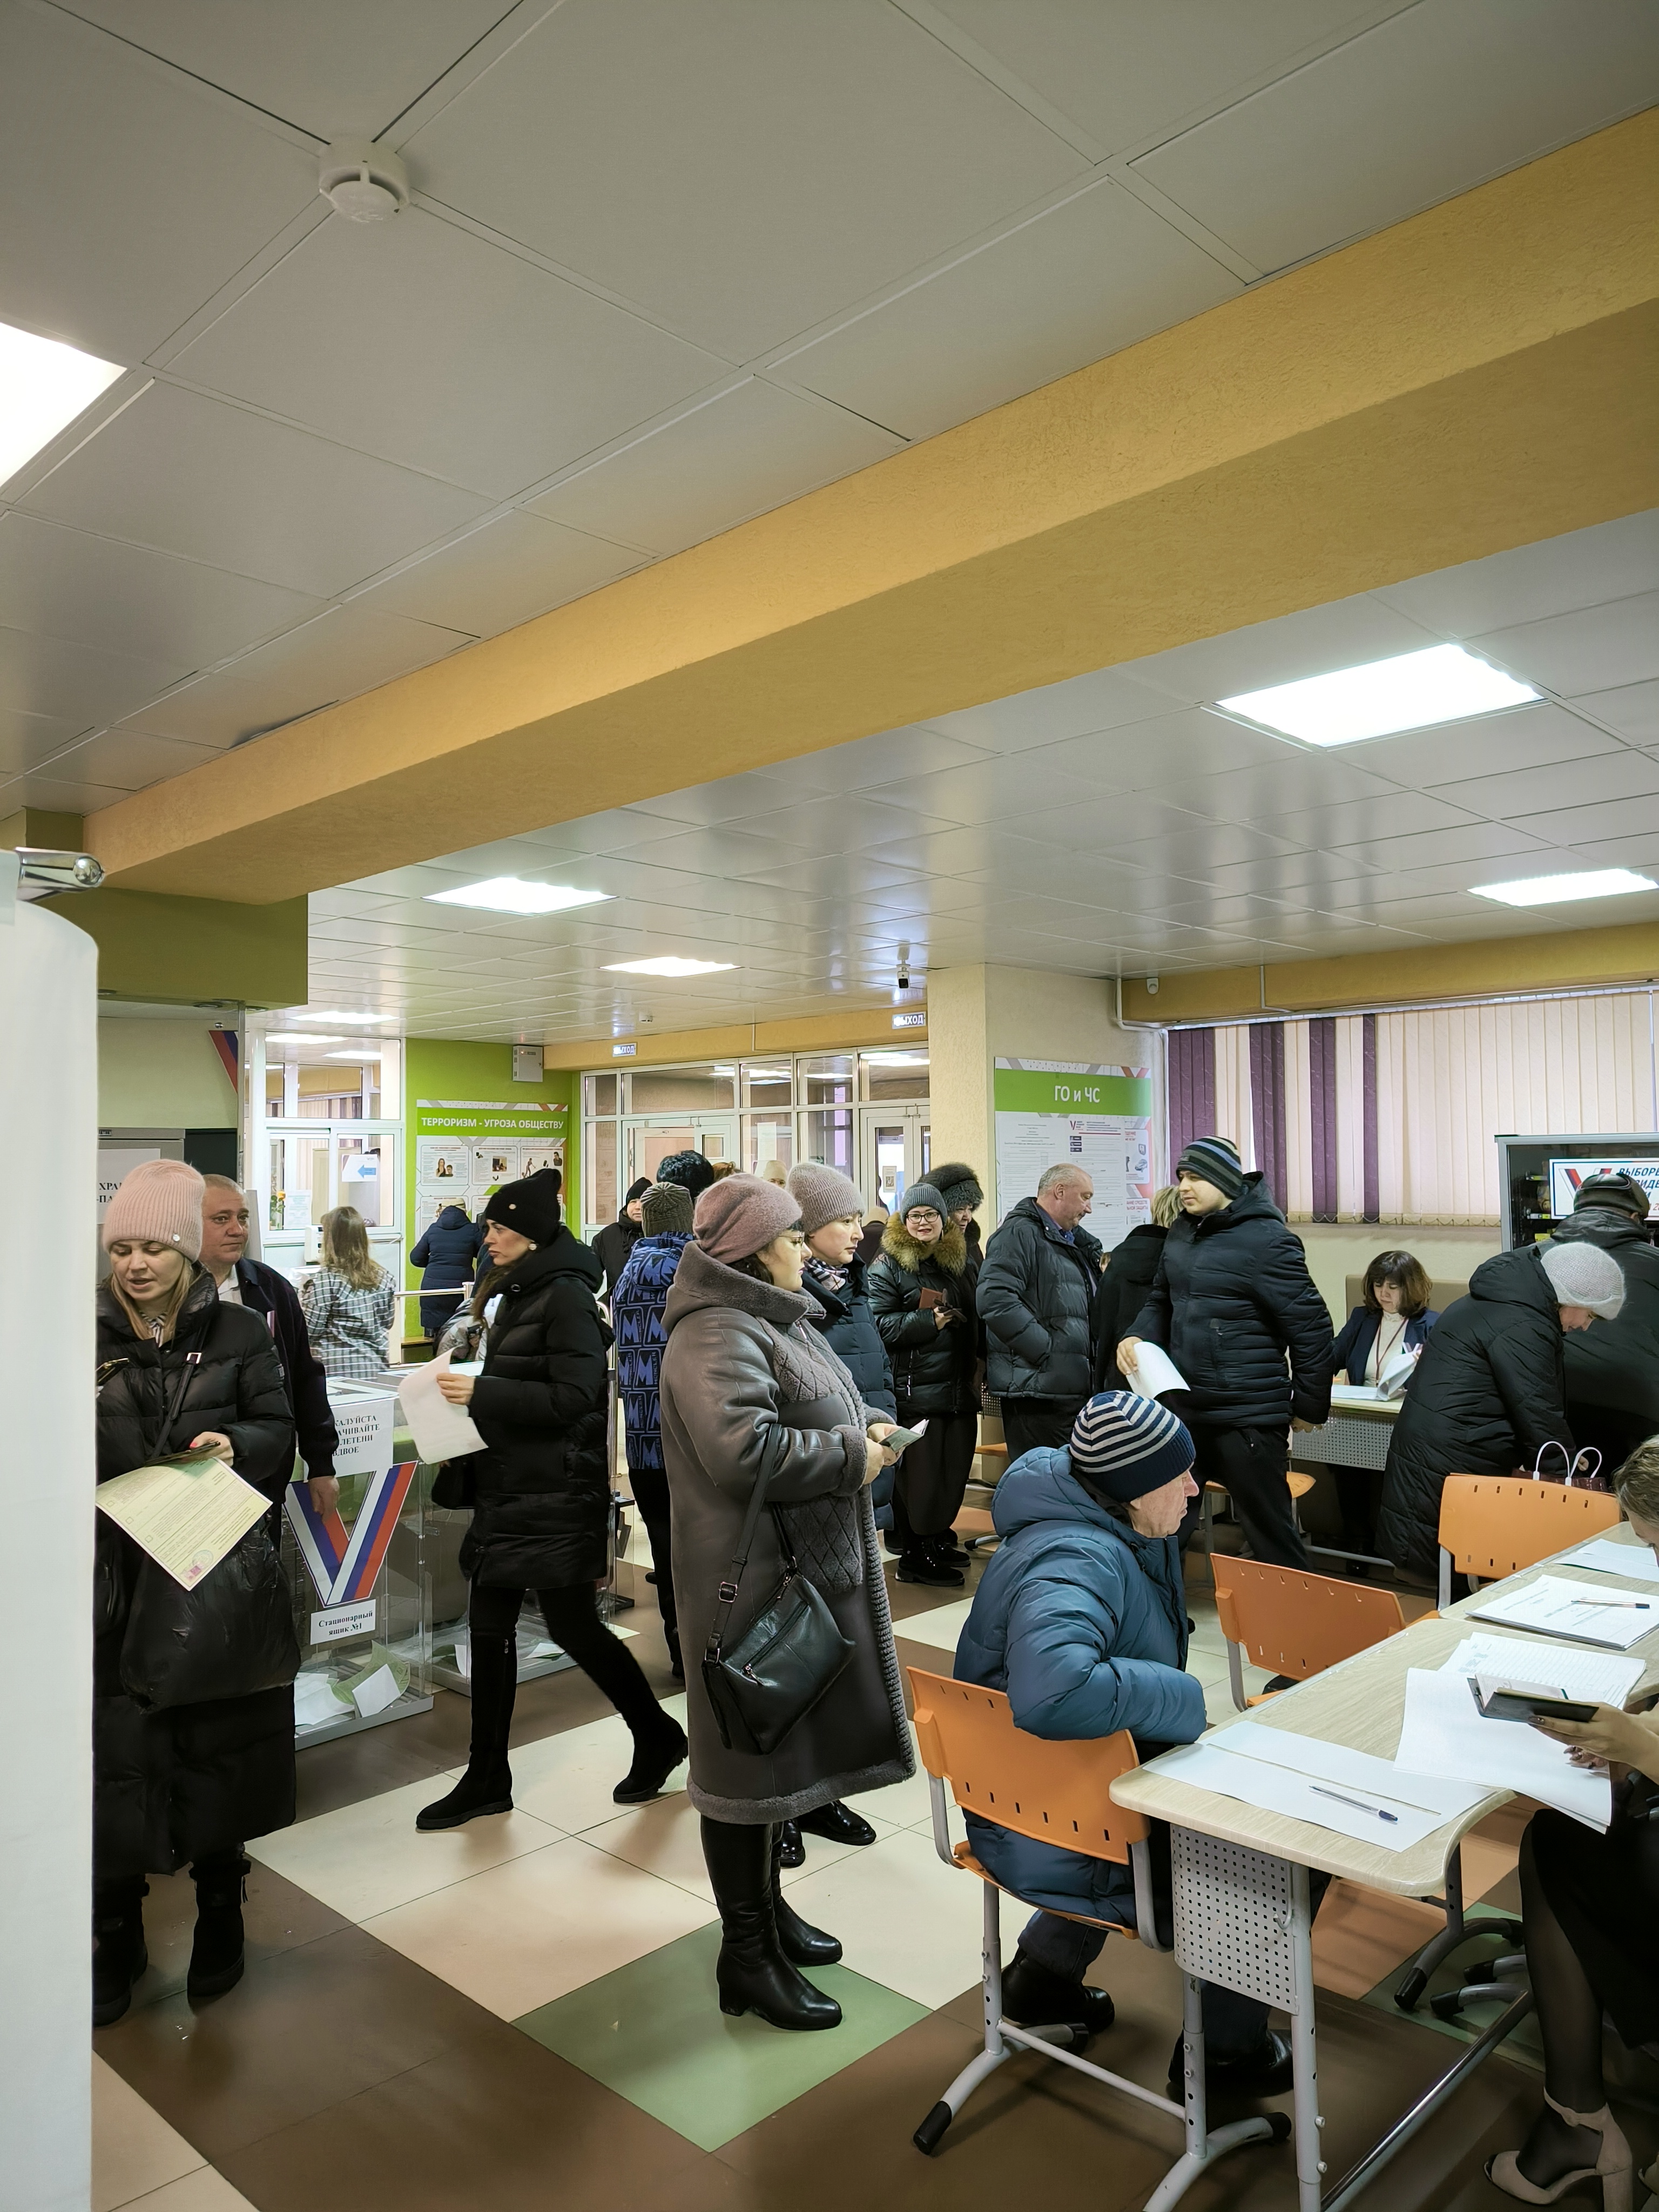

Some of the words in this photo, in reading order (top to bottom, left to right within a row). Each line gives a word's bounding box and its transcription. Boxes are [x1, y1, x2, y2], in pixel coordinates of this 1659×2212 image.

[1055, 1085, 1070, 1102] ГО
[1074, 1090, 1081, 1102] и
[1084, 1087, 1100, 1103] ЧС
[421, 1117, 476, 1127] ТЕРРОРИЗМ
[484, 1119, 516, 1128] УГРОЗА
[519, 1120, 563, 1129] ОБЩЕСТВУ
[333, 1446, 359, 1456] ВДВОЕ
[319, 1610, 373, 1627] Стационарный
[329, 1627, 349, 1636] ящик
[350, 1622, 362, 1631] №1
